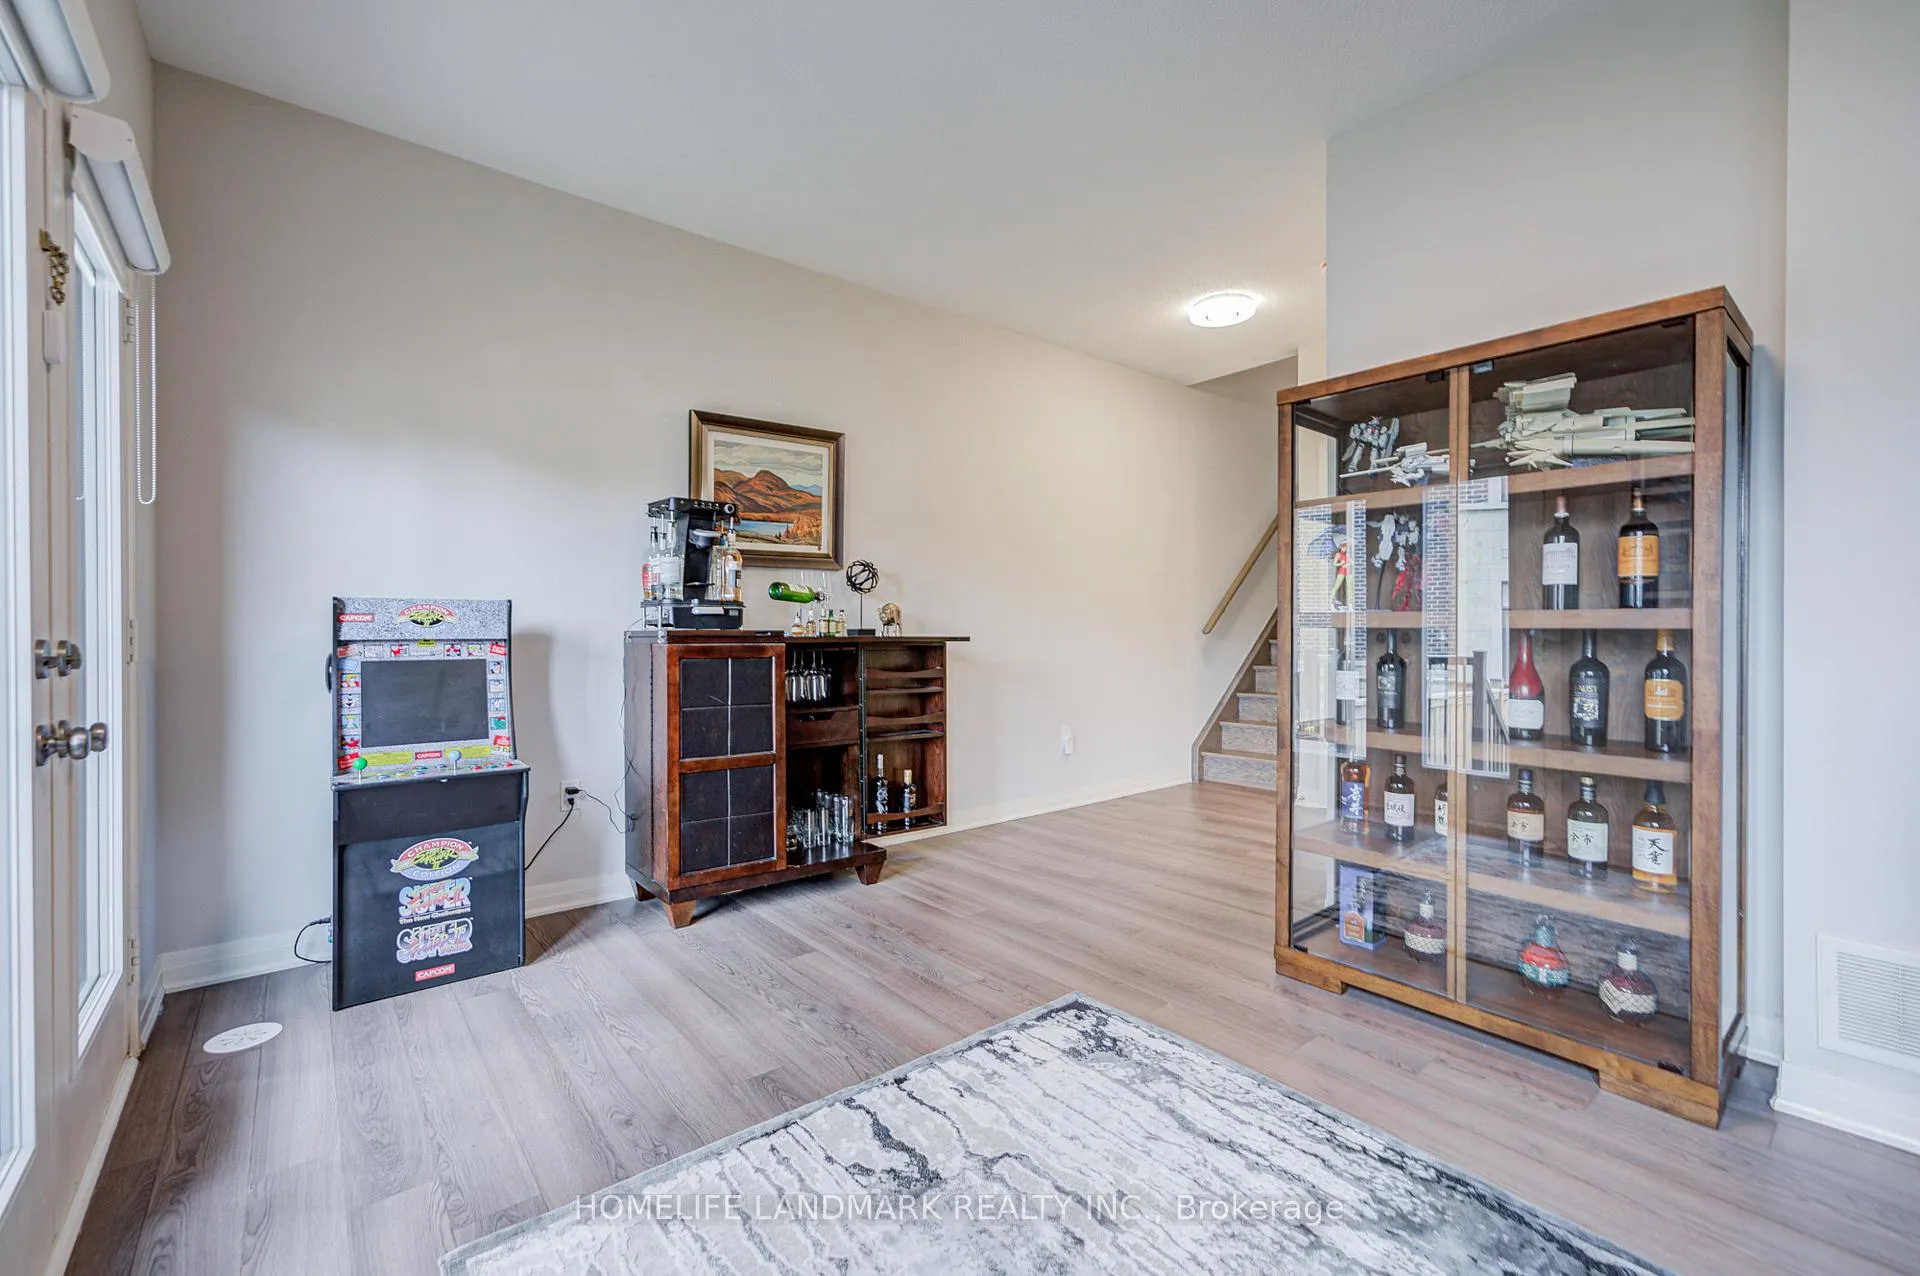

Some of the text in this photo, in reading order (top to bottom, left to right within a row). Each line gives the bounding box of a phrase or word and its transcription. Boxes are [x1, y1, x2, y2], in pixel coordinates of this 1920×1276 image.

[404, 604, 450, 616] CHAMPION
[416, 752, 442, 760] CAPCOM
[1570, 831, 1594, 846] 余市
[408, 841, 464, 858] CHAMPION
[412, 863, 461, 877] EDITION
[417, 966, 452, 979] CAPCOM
